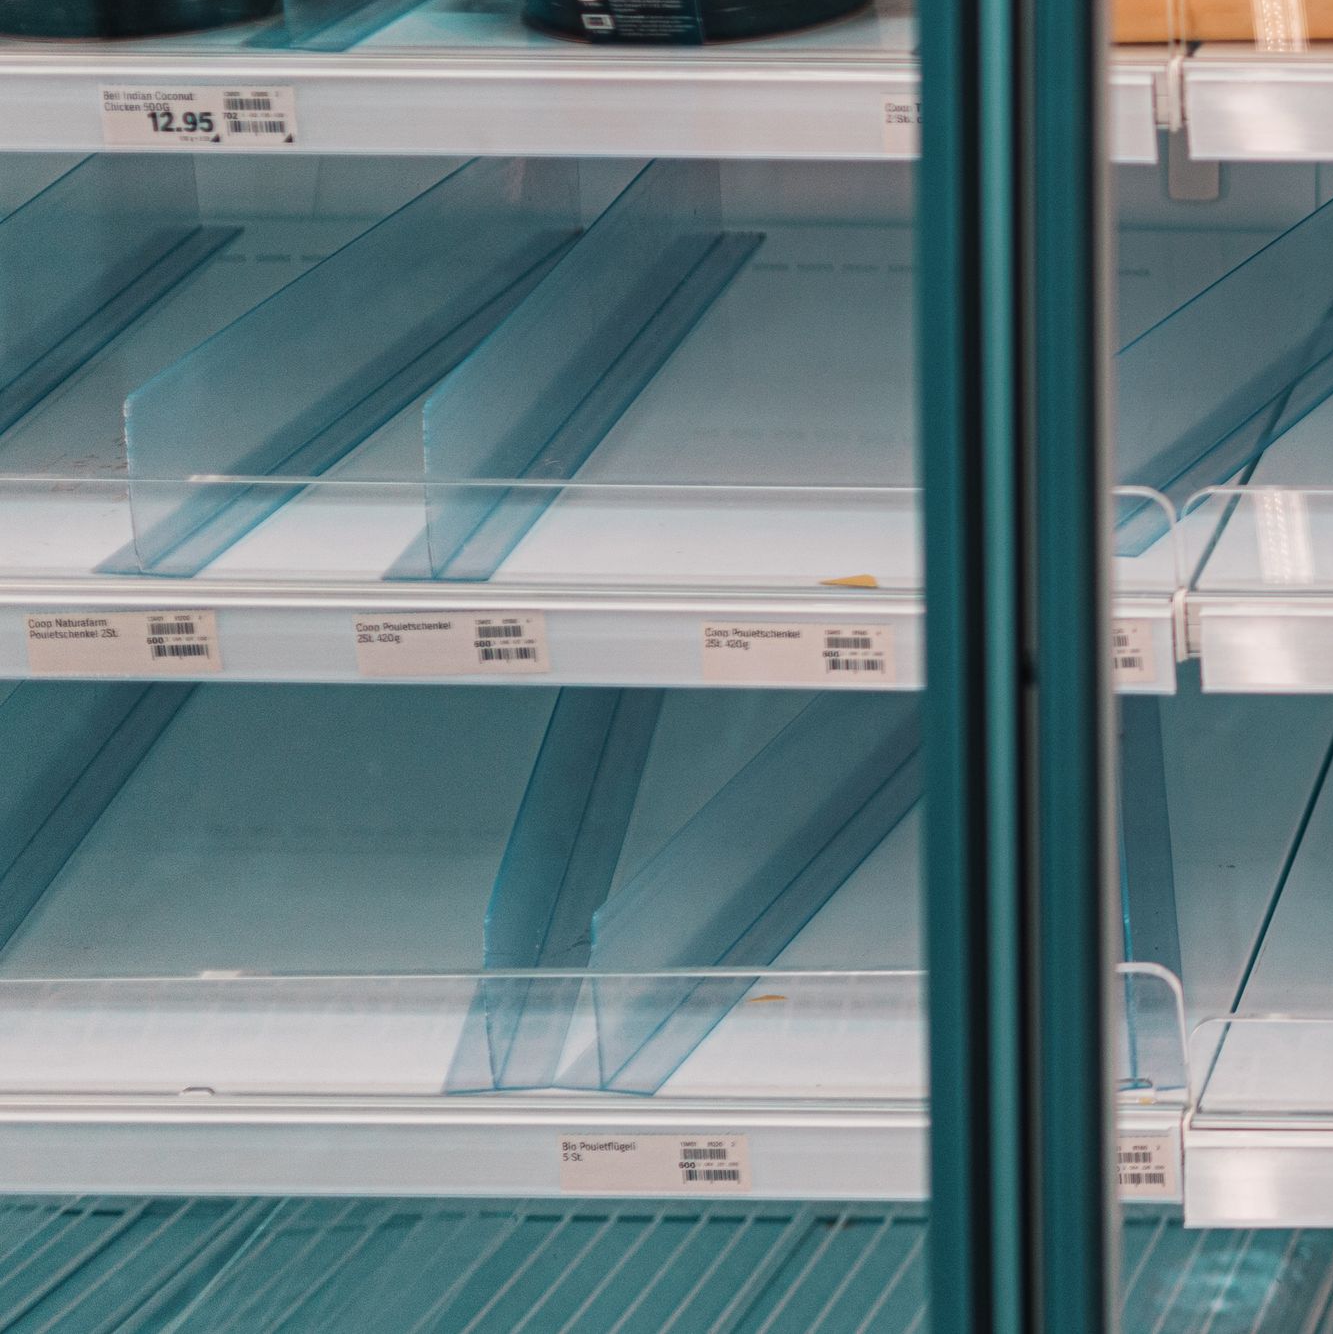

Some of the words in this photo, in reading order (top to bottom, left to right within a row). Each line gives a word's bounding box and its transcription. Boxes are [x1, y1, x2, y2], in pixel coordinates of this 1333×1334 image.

[123, 91, 152, 100] Indian
[155, 91, 194, 101] Coconut
[104, 102, 140, 111] Chicken
[147, 112, 214, 132] 12.95
[28, 619, 52, 629] Coop
[55, 619, 107, 628] Naturafarm
[356, 623, 380, 633] Coop
[382, 621, 451, 631] Pouletschenkel
[30, 629, 98, 639] Pouletschenkel
[562, 1142, 576, 1151] Bio
[580, 1141, 636, 1152] Pouletflügeli
[563, 1153, 569, 1161] 5
[571, 1153, 583, 1162] St.
